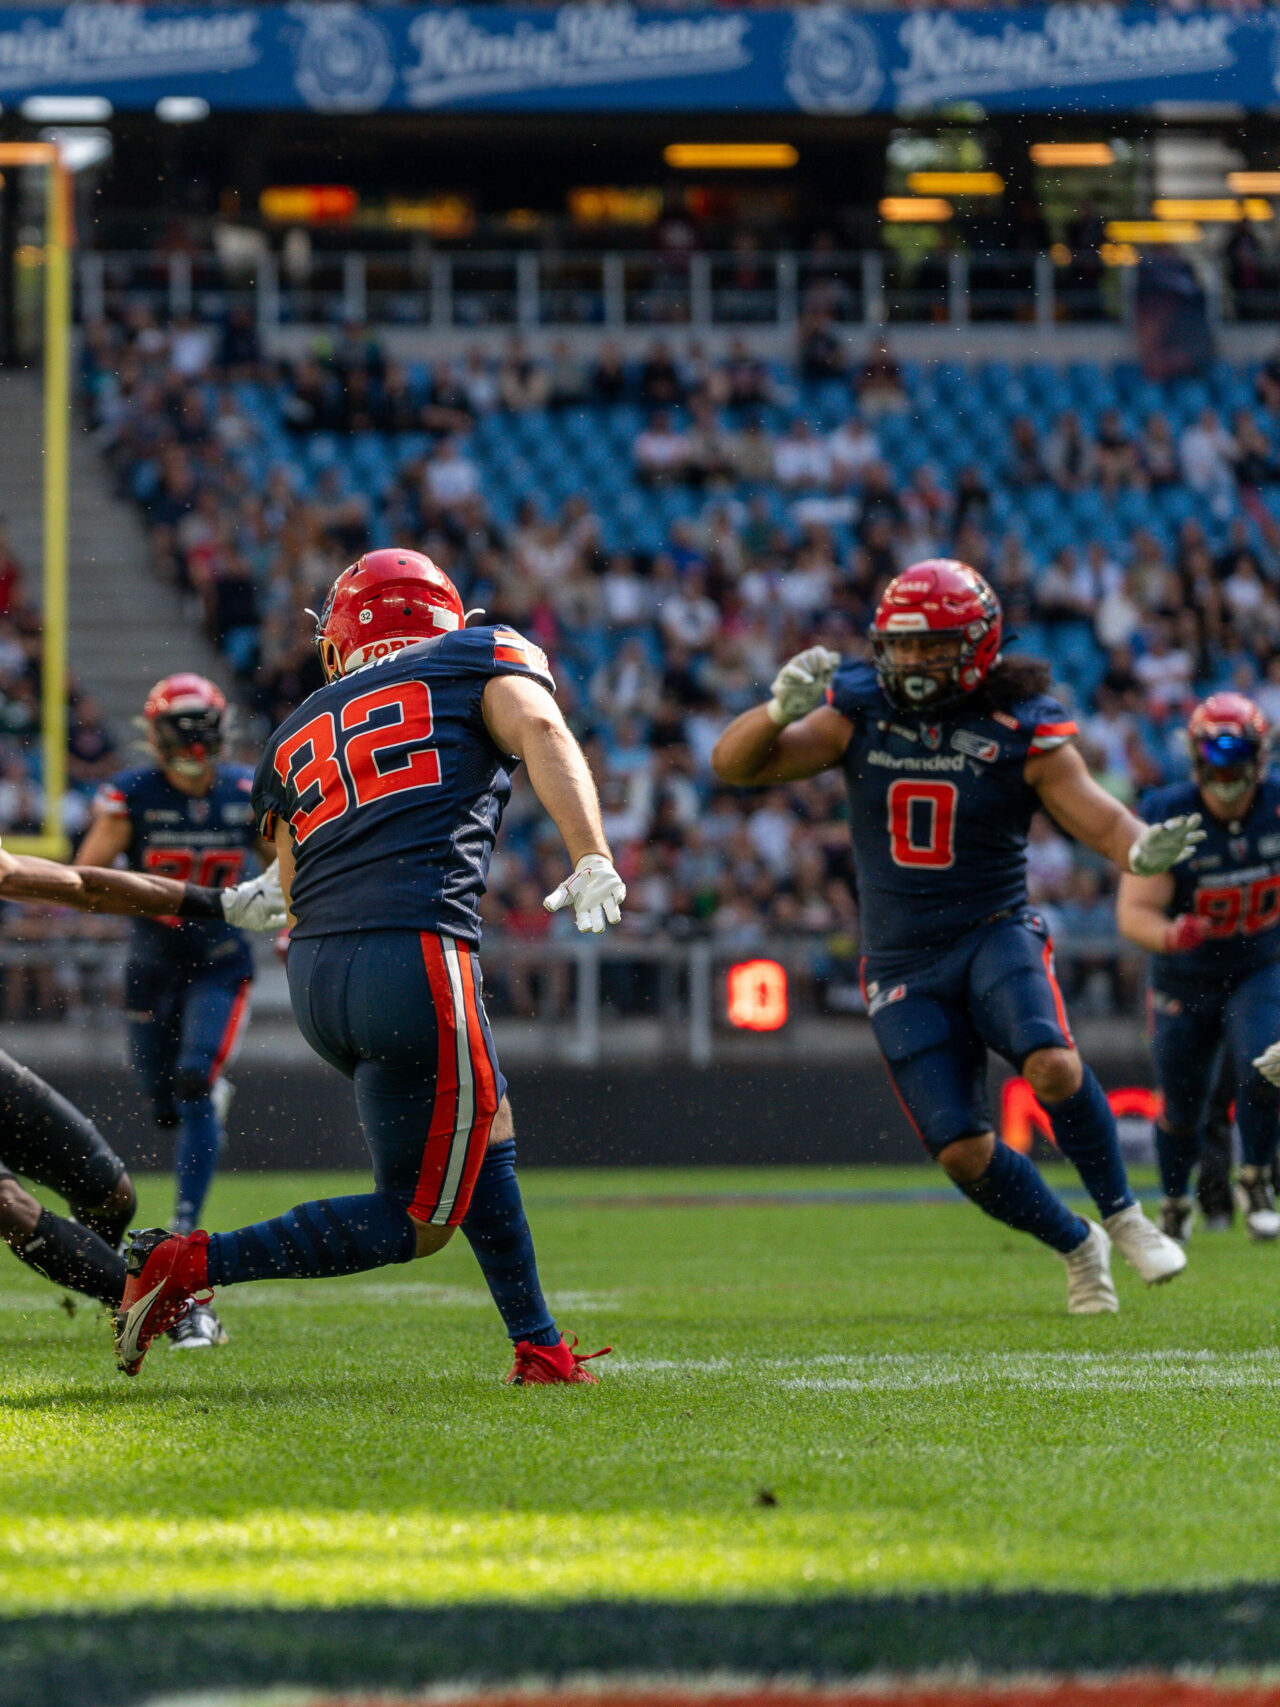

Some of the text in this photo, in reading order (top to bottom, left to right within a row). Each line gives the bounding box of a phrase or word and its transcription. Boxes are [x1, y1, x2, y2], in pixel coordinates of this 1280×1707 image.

[360, 612, 371, 621] 32
[274, 680, 442, 845] 32
[867, 750, 966, 771] allbranded
[887, 778, 959, 869] 0
